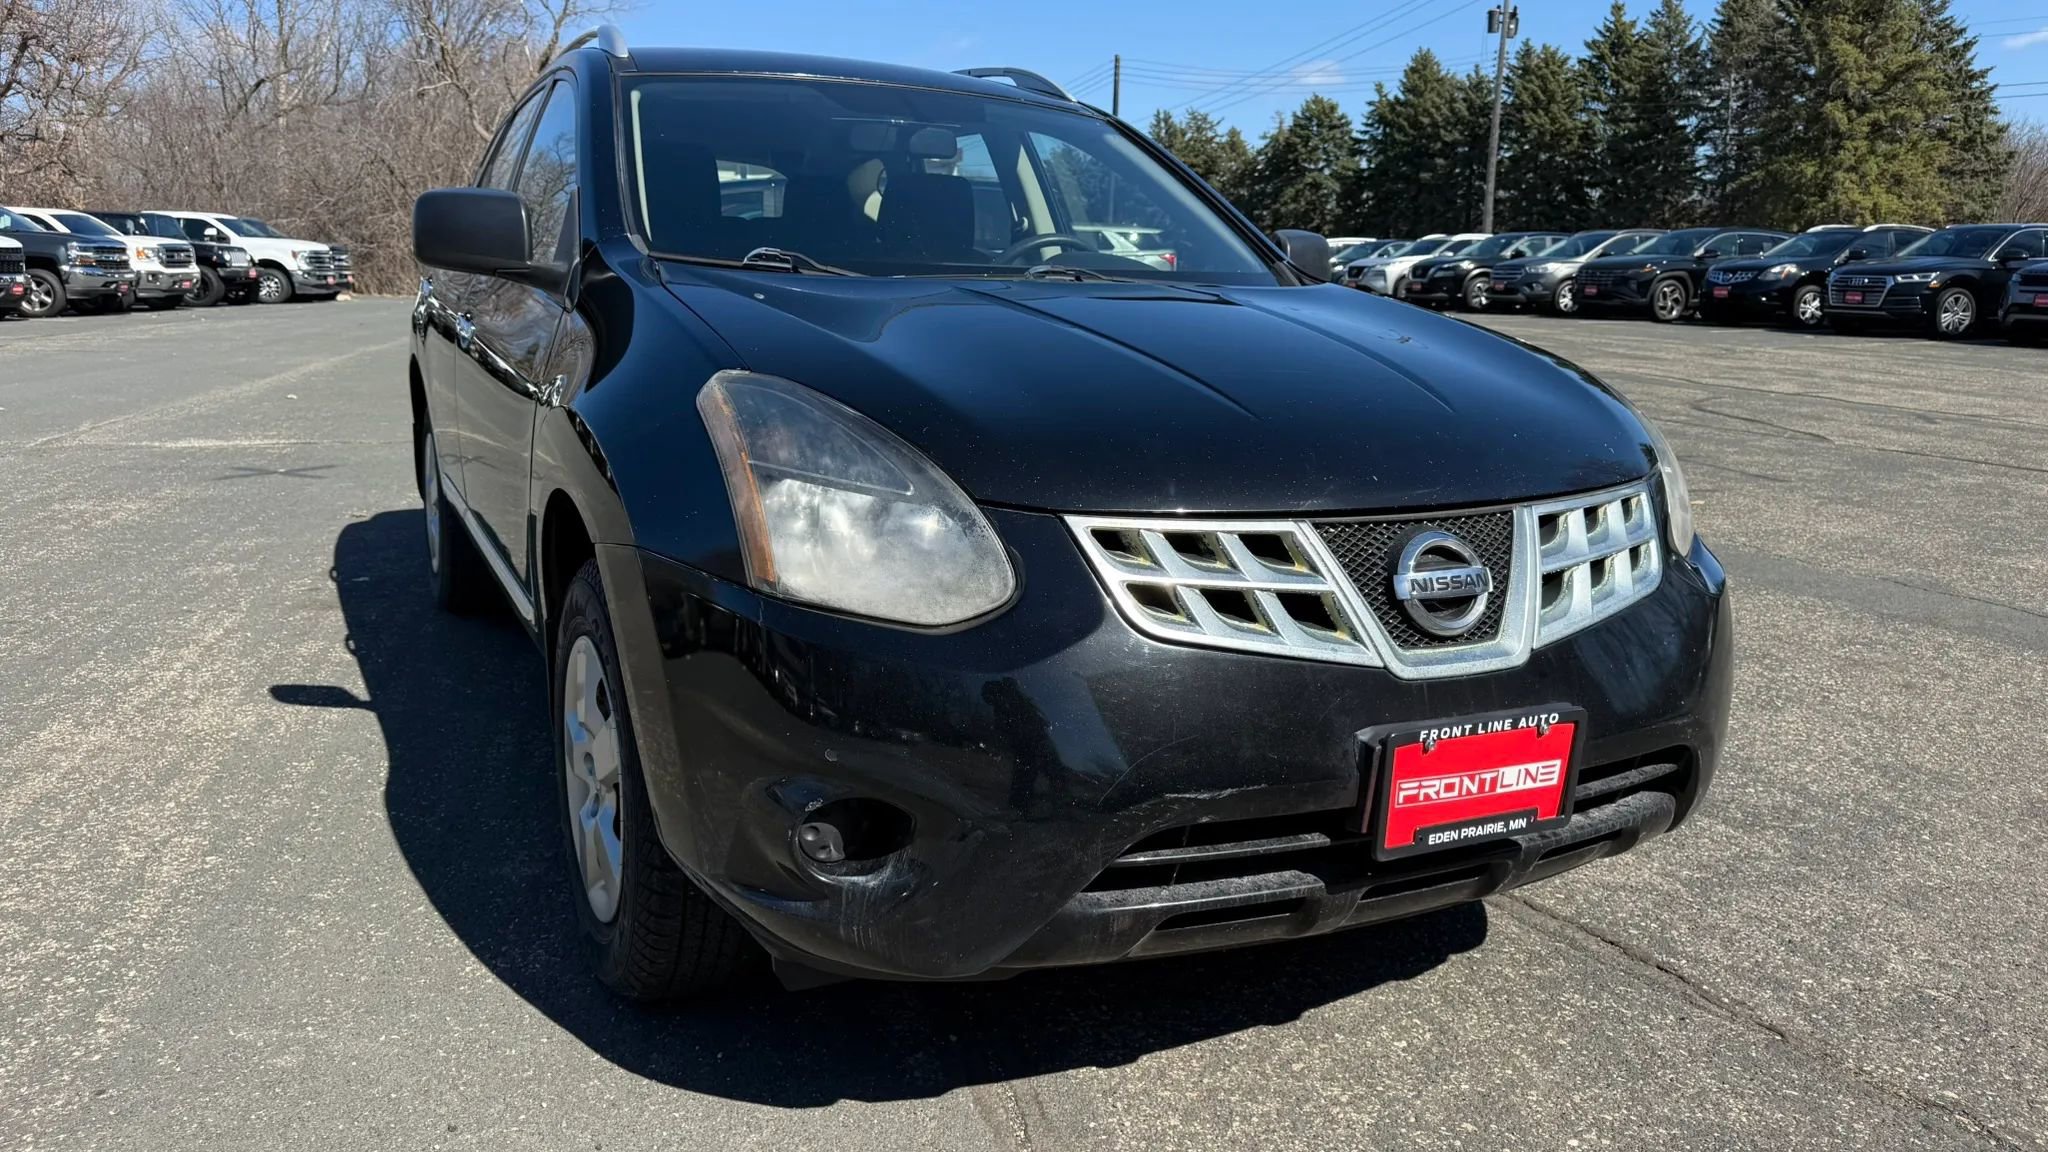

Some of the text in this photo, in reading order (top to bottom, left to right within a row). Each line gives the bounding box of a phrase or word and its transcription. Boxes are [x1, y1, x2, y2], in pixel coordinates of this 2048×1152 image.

[1411, 573, 1487, 592] NISSAN
[1420, 713, 1559, 742] FRONT LINE AUTO
[1428, 818, 1527, 845] EDEN PRAIRIE, MN
